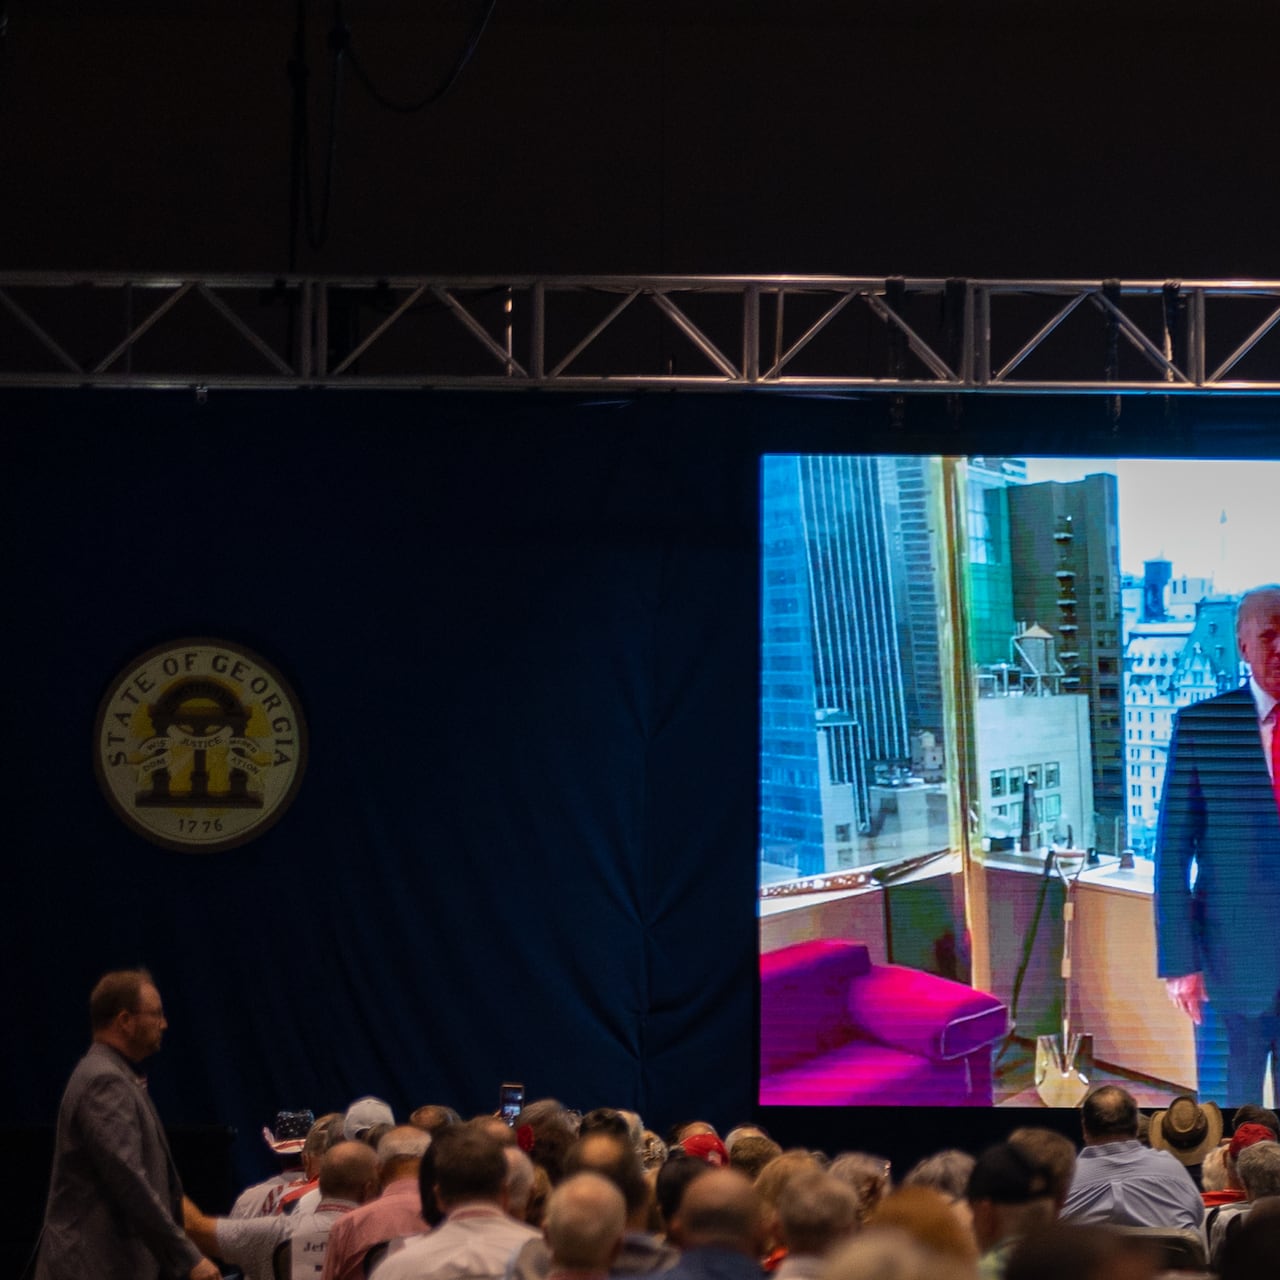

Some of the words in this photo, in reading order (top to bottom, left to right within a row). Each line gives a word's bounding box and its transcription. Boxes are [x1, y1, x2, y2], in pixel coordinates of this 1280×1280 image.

[108, 671, 156, 767] STATE
[163, 652, 198, 677] OF
[212, 654, 294, 767] GEORGIA
[181, 735, 224, 749] JUSTICE
[178, 818, 223, 833] 1776
